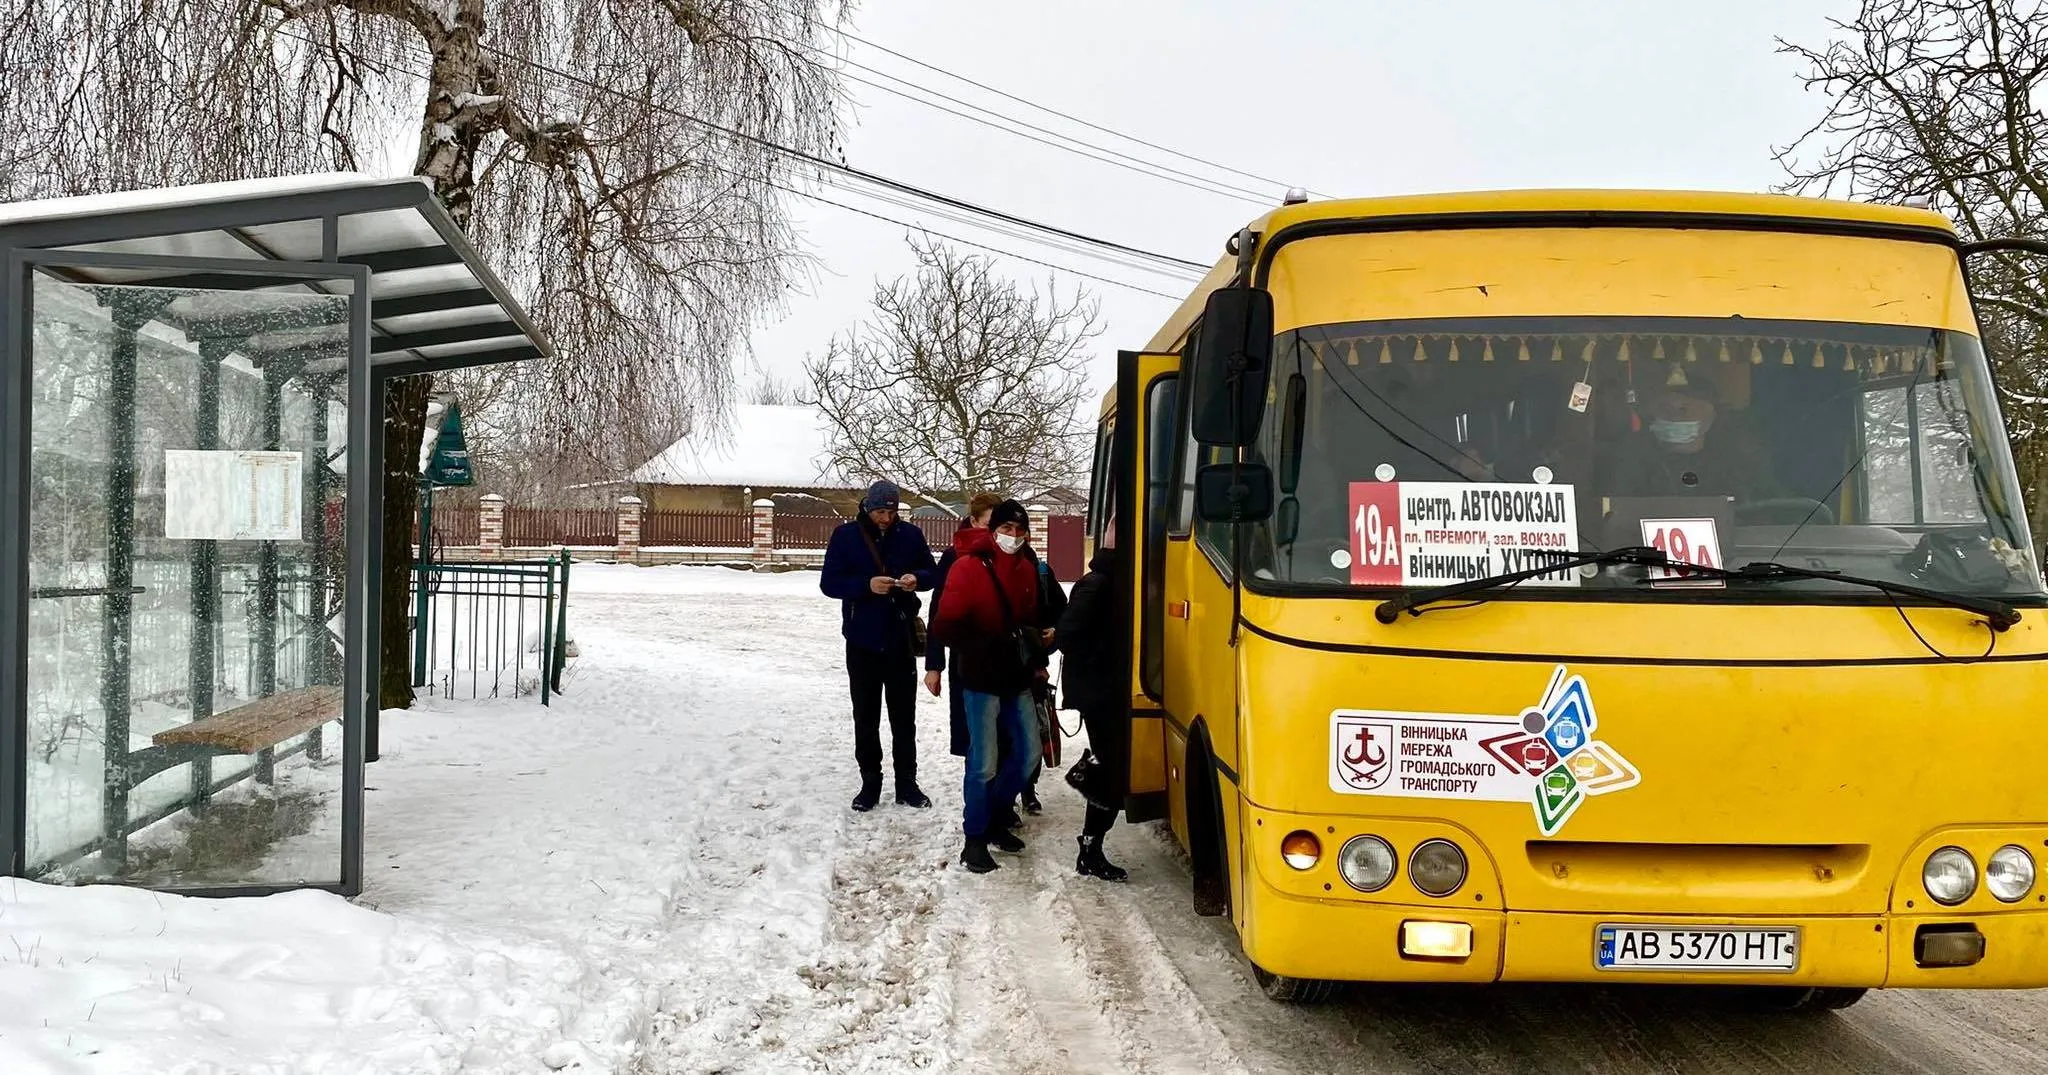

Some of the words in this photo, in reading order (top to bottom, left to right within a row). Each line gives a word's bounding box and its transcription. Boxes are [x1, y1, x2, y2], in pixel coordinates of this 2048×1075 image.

[1407, 497, 1456, 529] центр.
[1460, 490, 1566, 523] АВТОВОКЗАЛ
[1355, 503, 1400, 566] 19А
[1404, 533, 1422, 544] пл.
[1494, 534, 1518, 546] зал.
[1520, 532, 1567, 547] ВОКЗАЛ
[1409, 546, 1491, 583] вінницькі
[1400, 725, 1468, 742] ВІННИЦЬКА
[1400, 743, 1453, 758] МЕРЕЖА
[1400, 760, 1496, 777] ГРОМАДСЬКОГО
[1400, 776, 1478, 793] ТРАНСПОРТУ
[1619, 931, 1660, 960] AB
[1669, 932, 1737, 960] 5370
[1744, 932, 1787, 960] HT
[1600, 950, 1614, 960] UA
